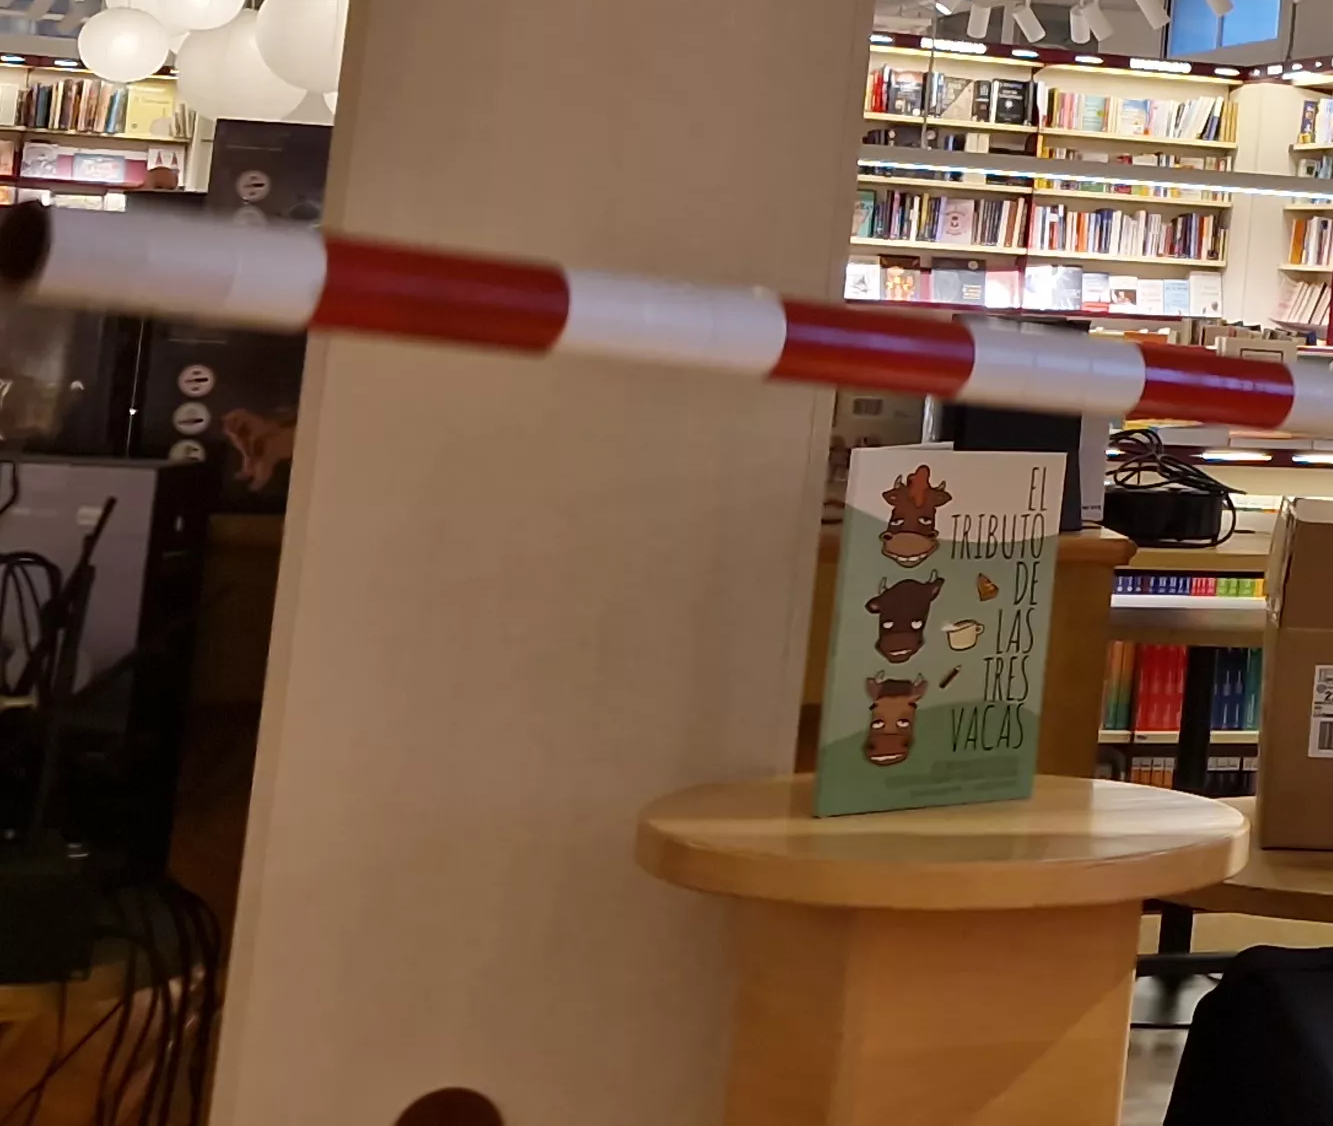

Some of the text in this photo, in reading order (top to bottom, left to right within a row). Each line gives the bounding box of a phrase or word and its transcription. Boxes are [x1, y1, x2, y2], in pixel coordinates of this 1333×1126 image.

[1027, 466, 1047, 512] EL
[950, 512, 1046, 560] TRIBUTO
[1013, 561, 1041, 606] DE
[995, 607, 1036, 655] LAS
[983, 655, 1029, 702] TRES
[951, 703, 1025, 753] VACAS
